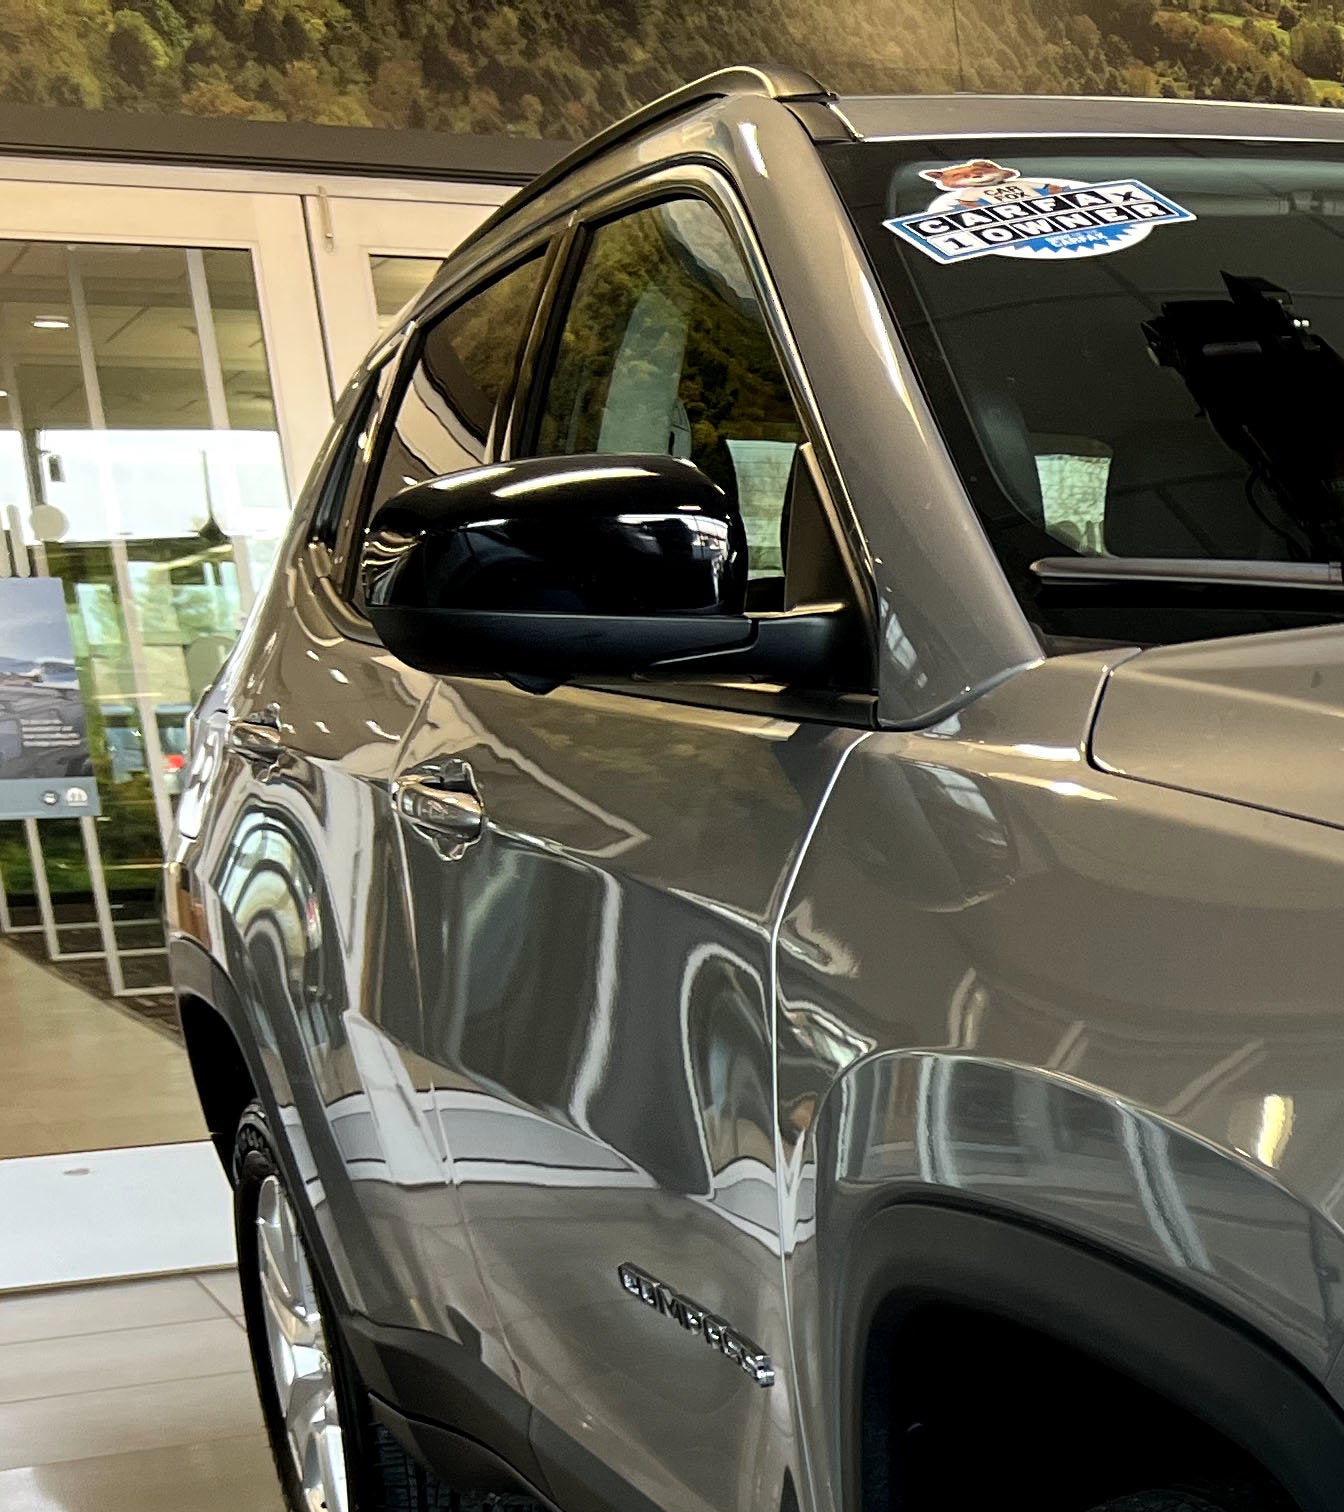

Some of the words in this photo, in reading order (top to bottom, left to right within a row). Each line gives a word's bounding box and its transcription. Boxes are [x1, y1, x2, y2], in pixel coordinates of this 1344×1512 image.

[984, 185, 1023, 197] CAR
[994, 191, 1031, 203] FOX
[915, 190, 1144, 235] CARFAX
[980, 205, 1168, 243] OWNER
